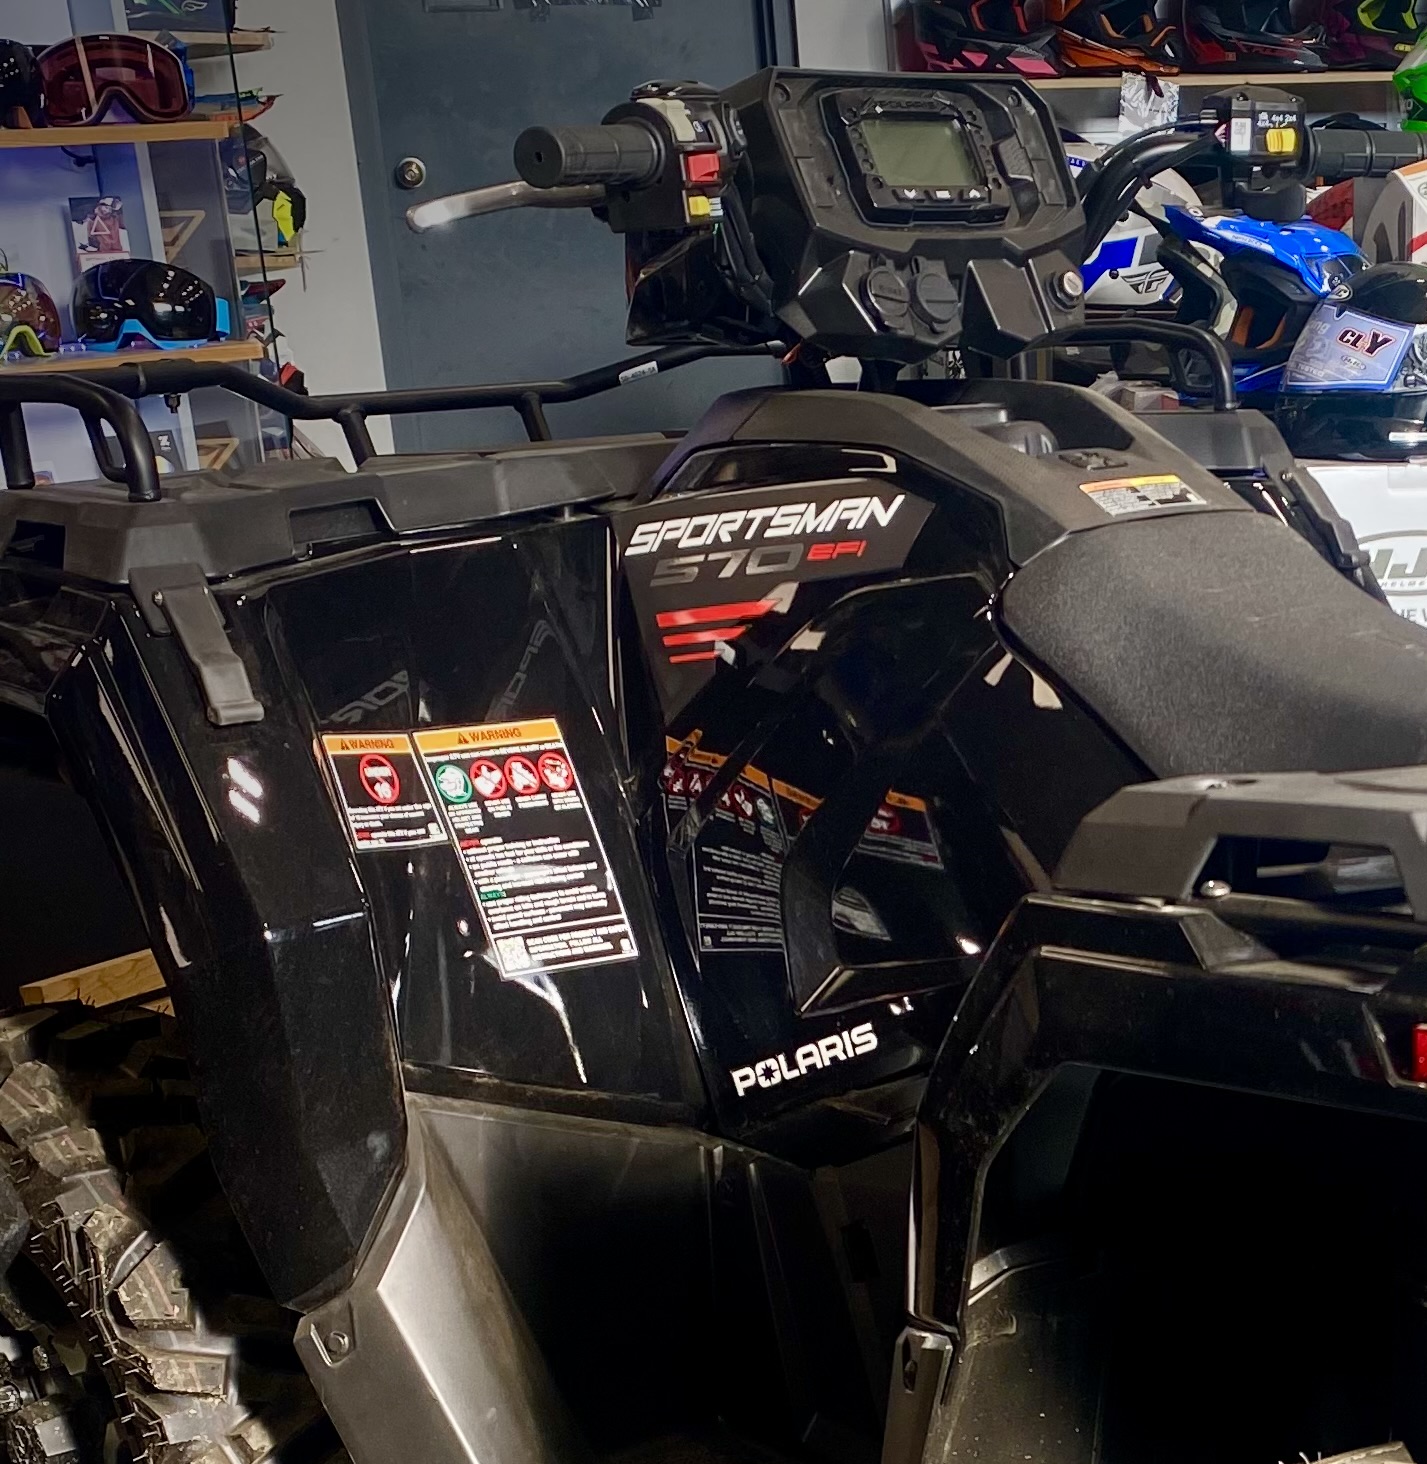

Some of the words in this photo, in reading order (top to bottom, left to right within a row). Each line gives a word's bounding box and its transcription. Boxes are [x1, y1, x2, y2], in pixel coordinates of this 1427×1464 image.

[625, 494, 905, 556] SPORTSMAN
[650, 543, 804, 587] 570
[806, 540, 867, 561] EFI
[468, 727, 523, 742] WARNING
[730, 1022, 878, 1097] POLARIS
